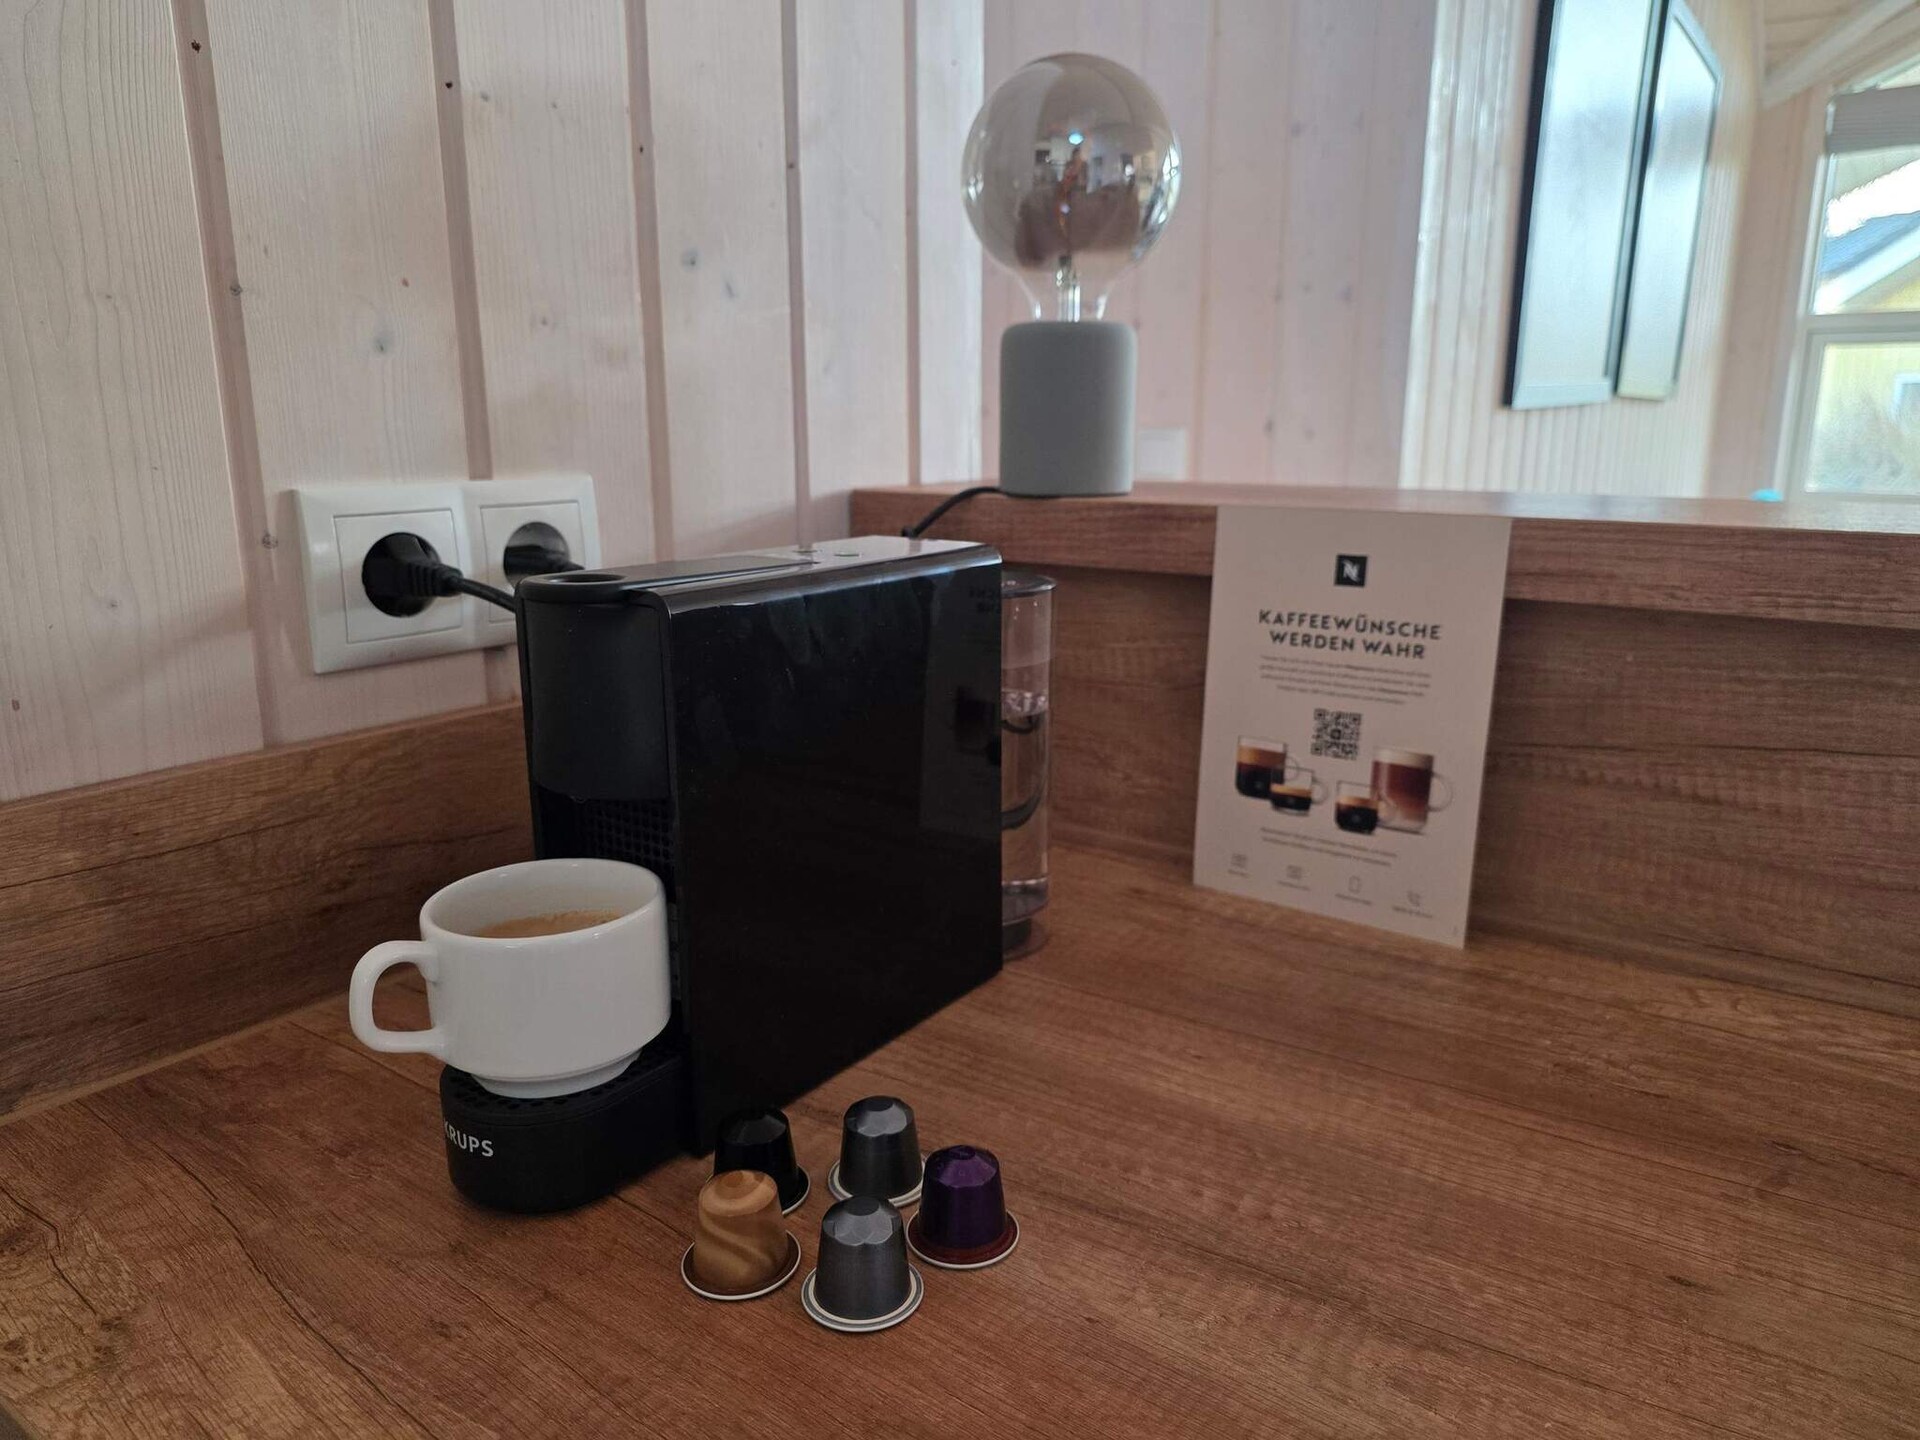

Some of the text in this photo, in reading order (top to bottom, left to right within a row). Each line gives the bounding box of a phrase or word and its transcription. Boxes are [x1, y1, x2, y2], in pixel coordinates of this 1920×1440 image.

[1258, 609, 1441, 640] KAFFEEWÜNSCHE
[1269, 630, 1426, 660] WERDEN WAHR
